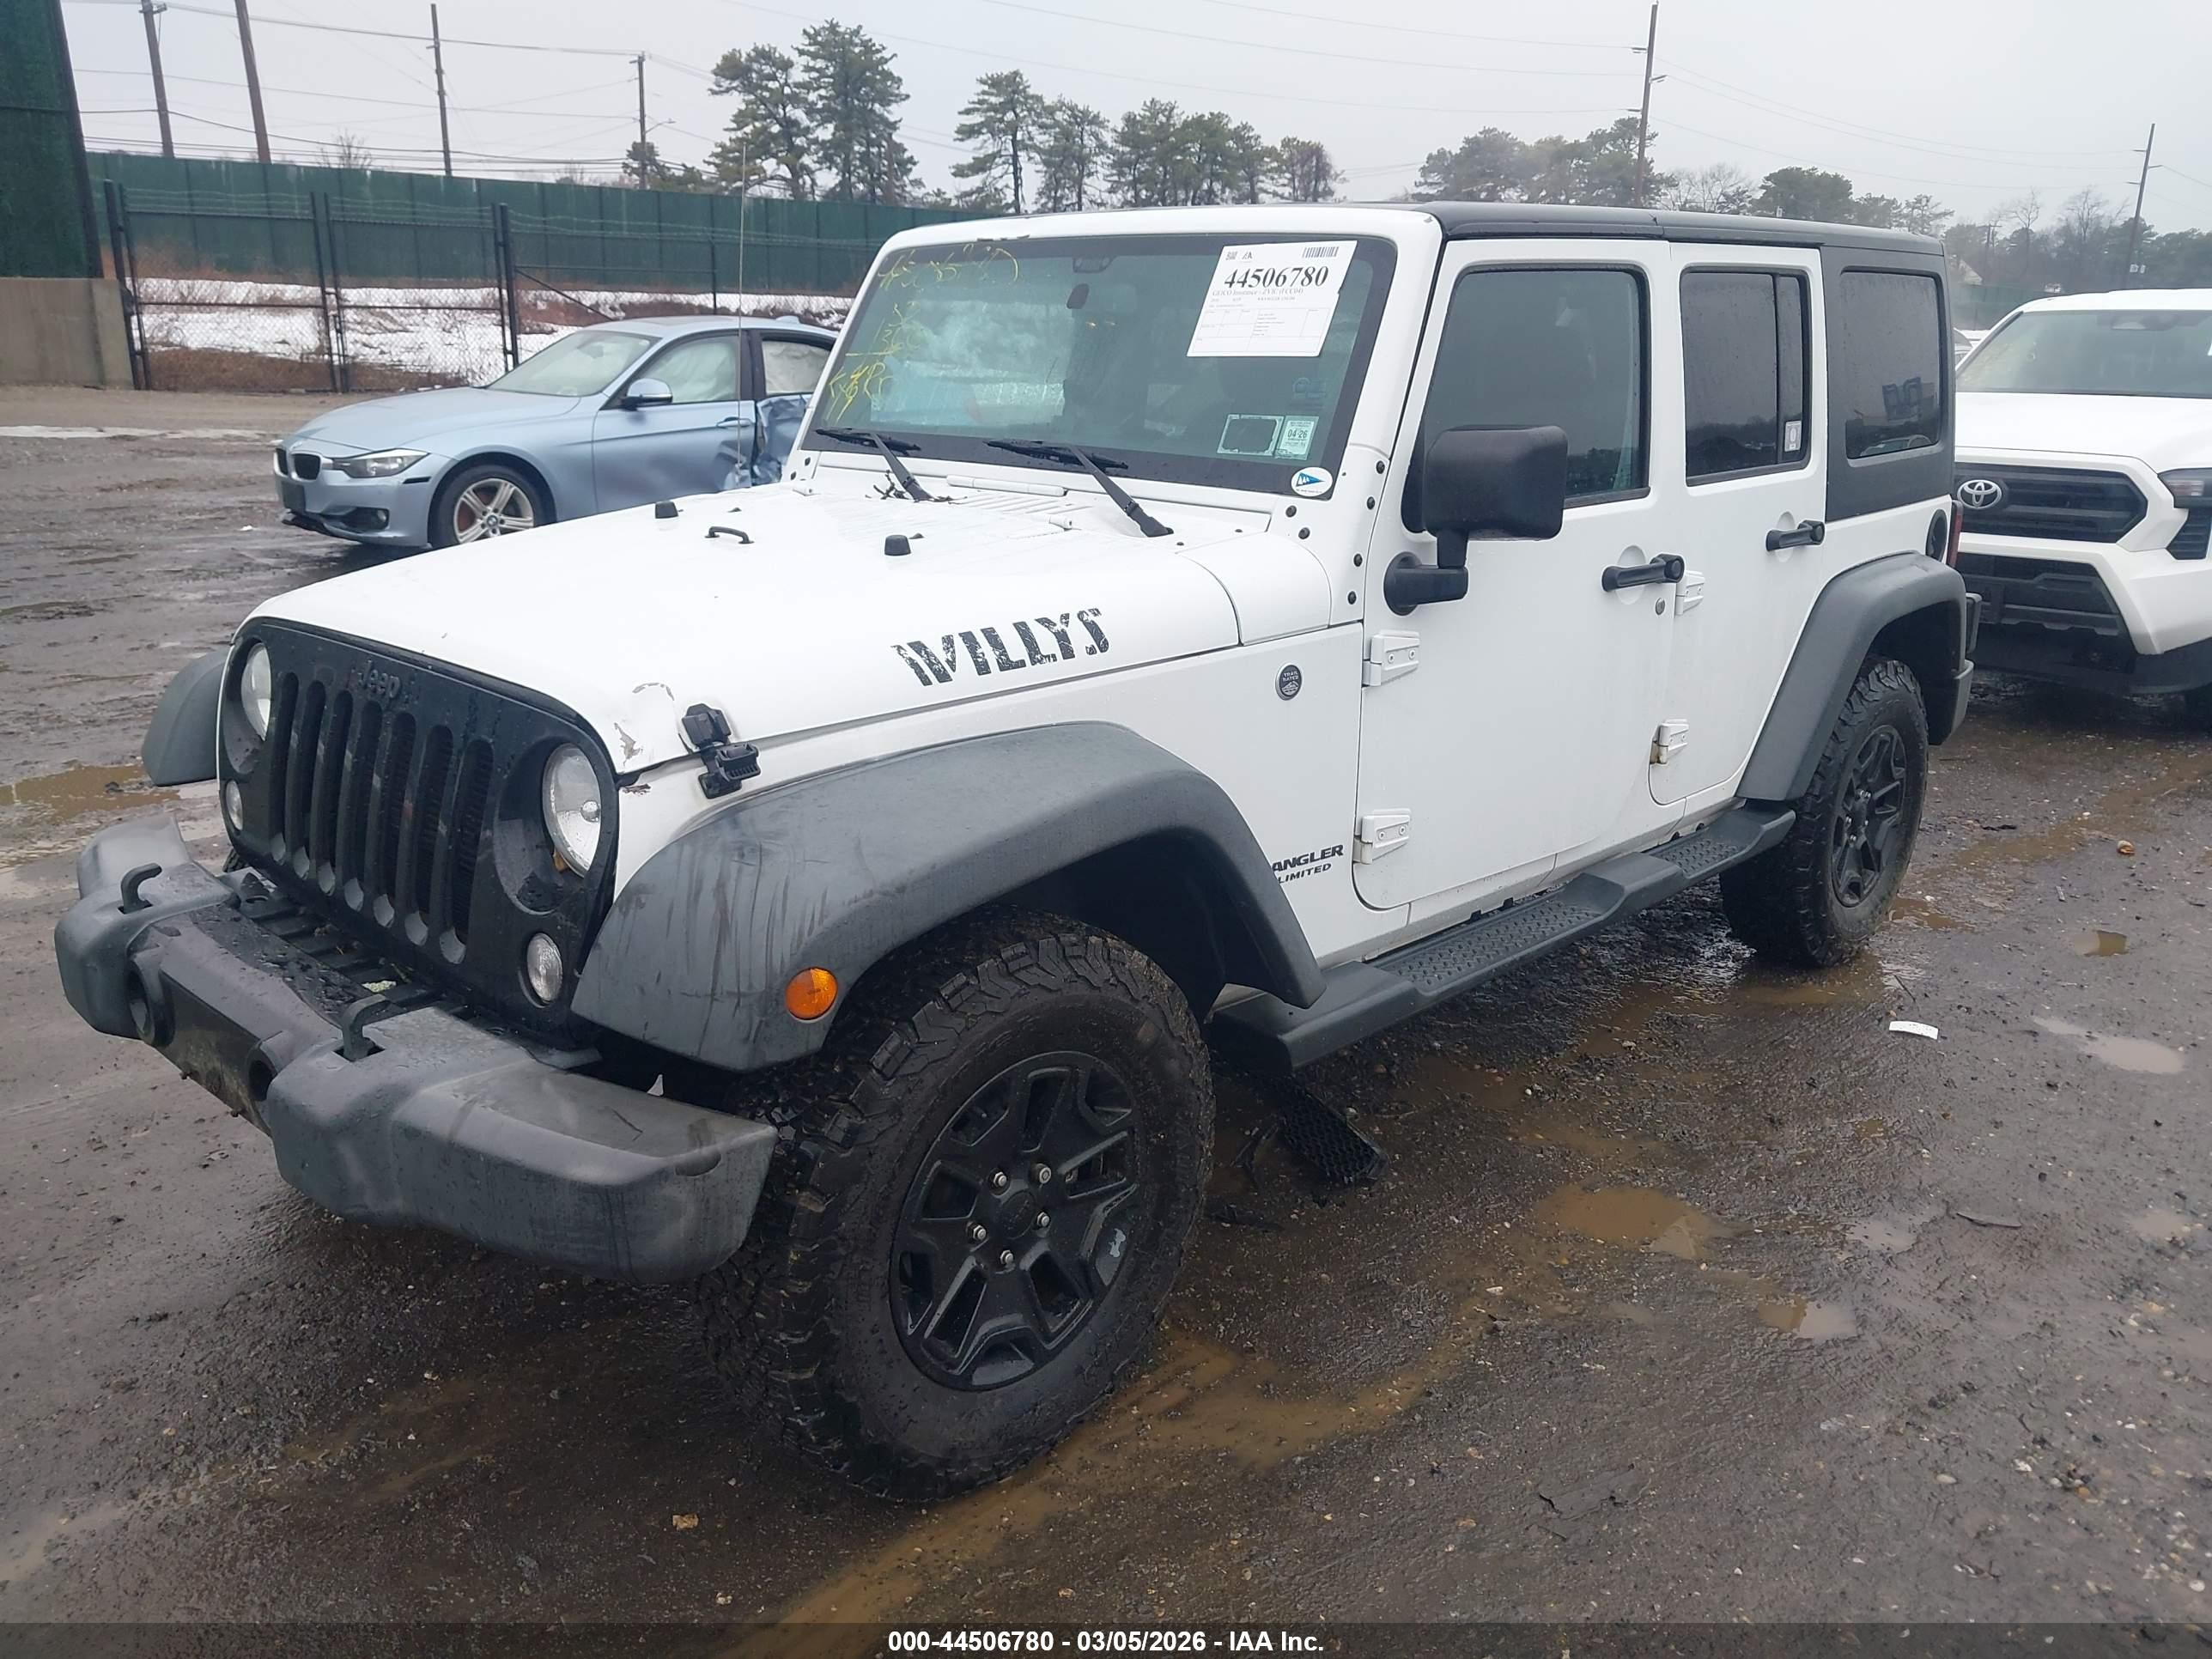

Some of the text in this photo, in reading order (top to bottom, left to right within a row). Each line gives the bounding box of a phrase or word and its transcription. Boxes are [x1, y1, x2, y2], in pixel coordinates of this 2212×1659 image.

[1224, 265, 1328, 288] 44506780
[890, 607, 1109, 687] WILLYS
[356, 659, 401, 701] Jeep
